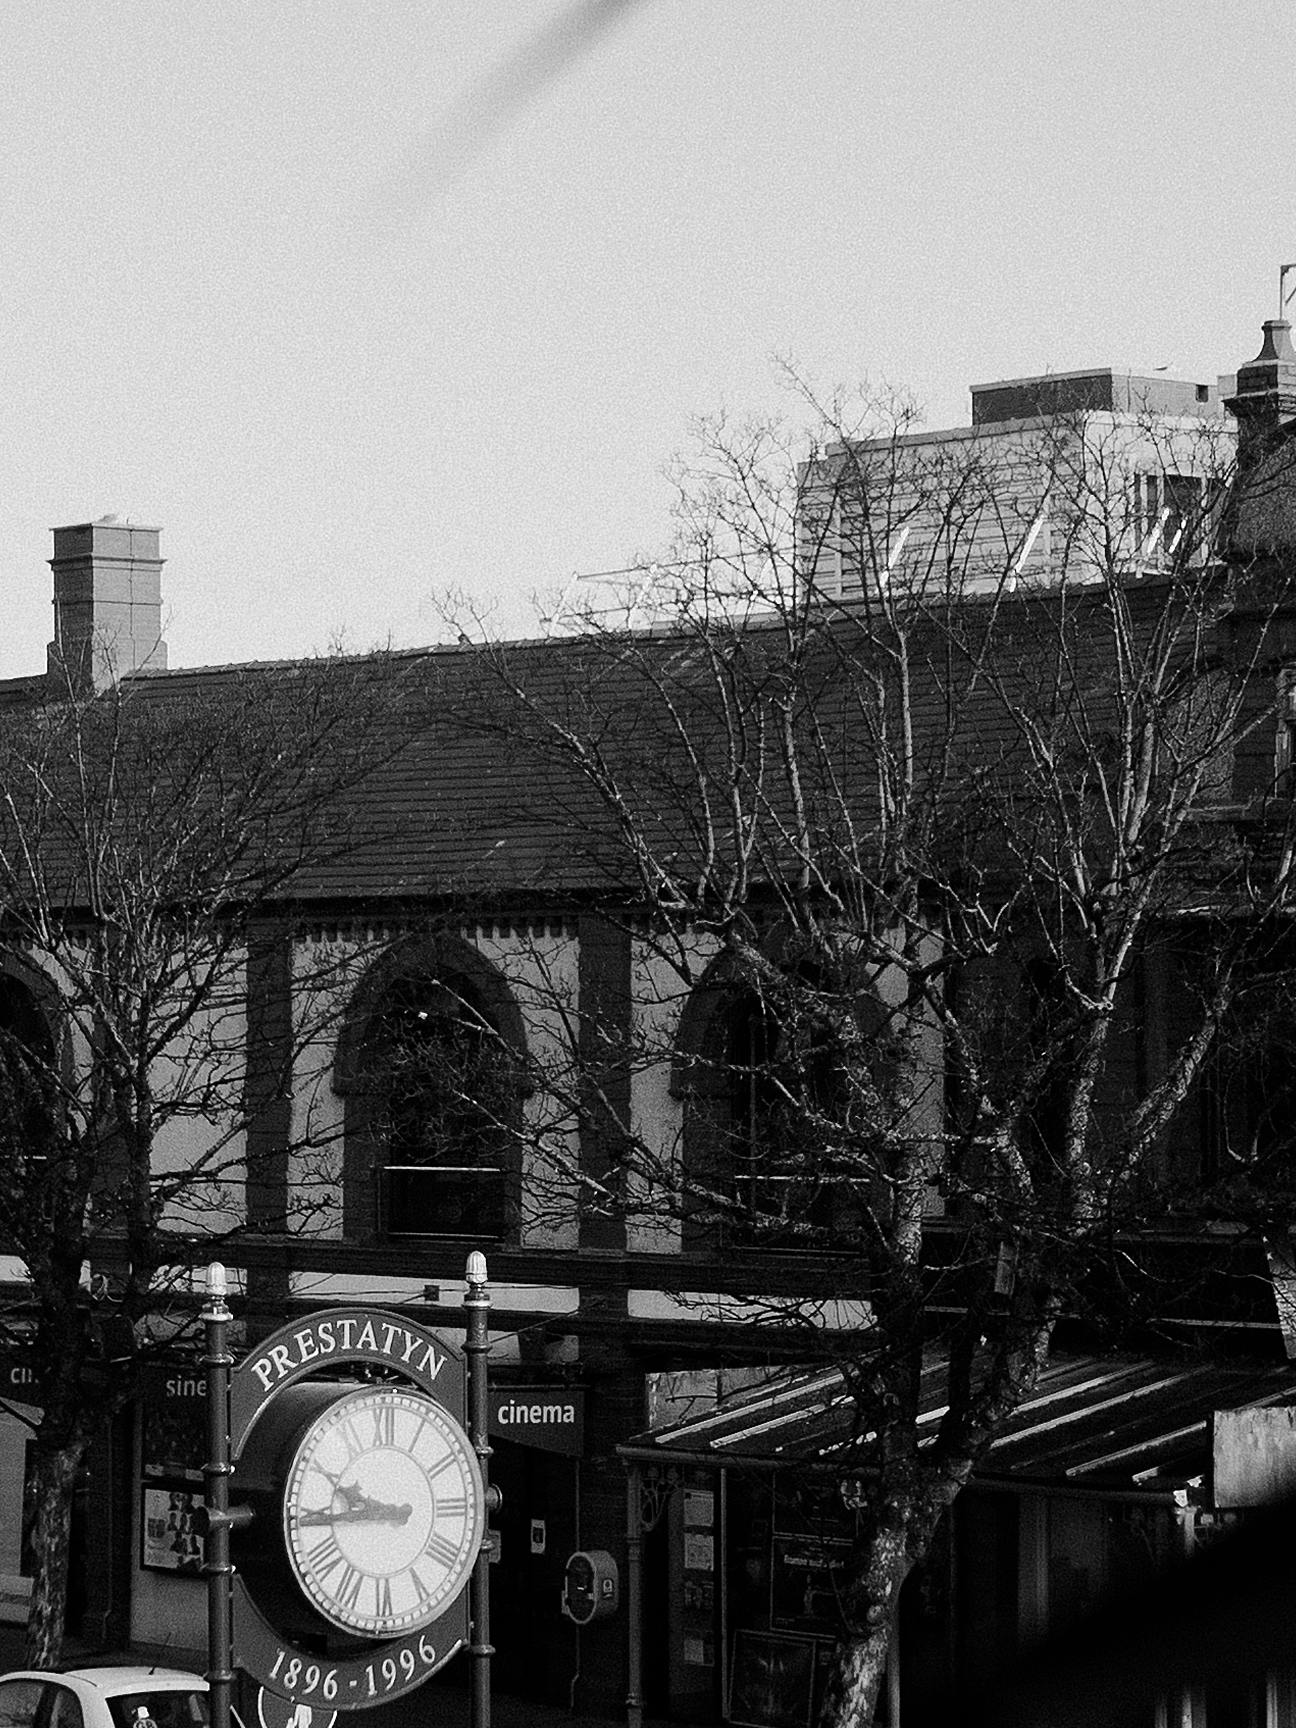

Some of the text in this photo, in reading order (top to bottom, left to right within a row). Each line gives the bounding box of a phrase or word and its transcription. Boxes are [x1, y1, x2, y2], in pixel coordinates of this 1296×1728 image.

[251, 1319, 448, 1393] PRESTATYN
[165, 1374, 208, 1398] sine
[497, 1399, 575, 1424] cinema
[269, 1648, 338, 1700] 1896
[365, 1634, 437, 1696] 1996
